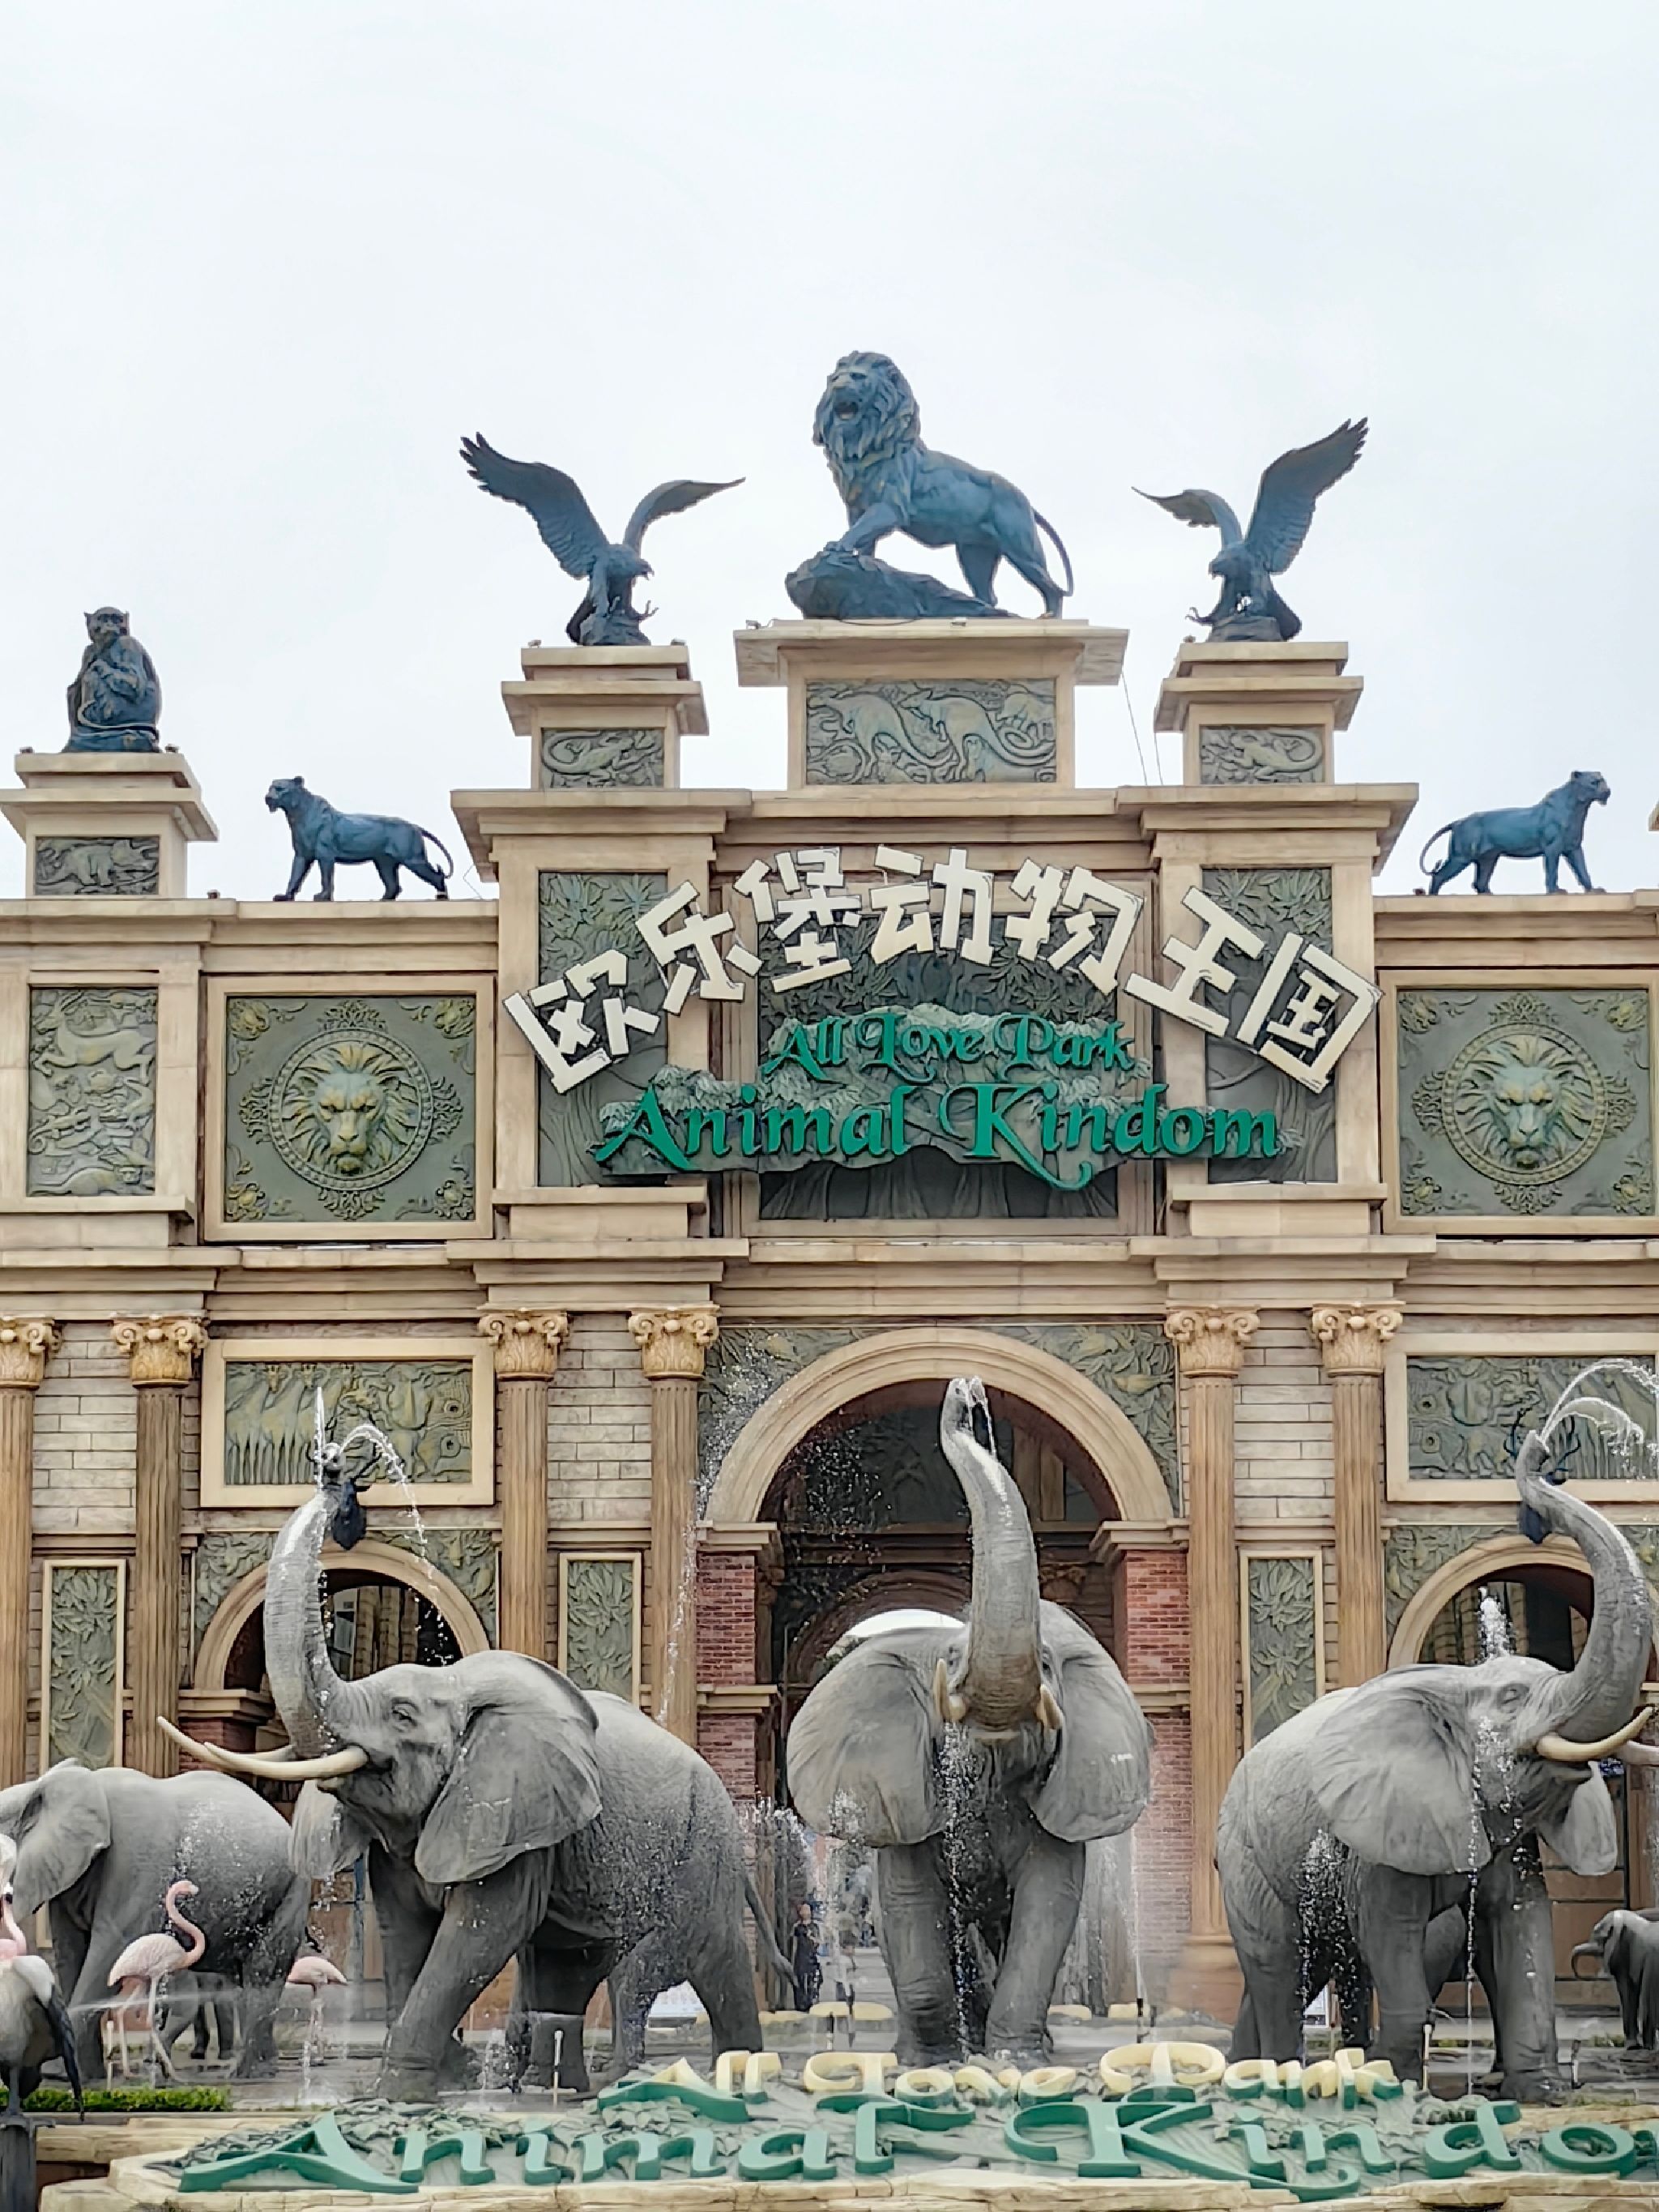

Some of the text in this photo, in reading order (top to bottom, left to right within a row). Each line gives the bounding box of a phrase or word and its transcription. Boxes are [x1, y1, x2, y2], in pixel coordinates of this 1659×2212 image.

[503, 845, 1384, 1094] 欧乐堡动物王国
[761, 1013, 1135, 1083] All Love Park
[595, 1083, 1282, 1191] Animal Kindom
[597, 2042, 1405, 2132] All Love Park
[178, 2100, 1659, 2202] Animal Kindo
